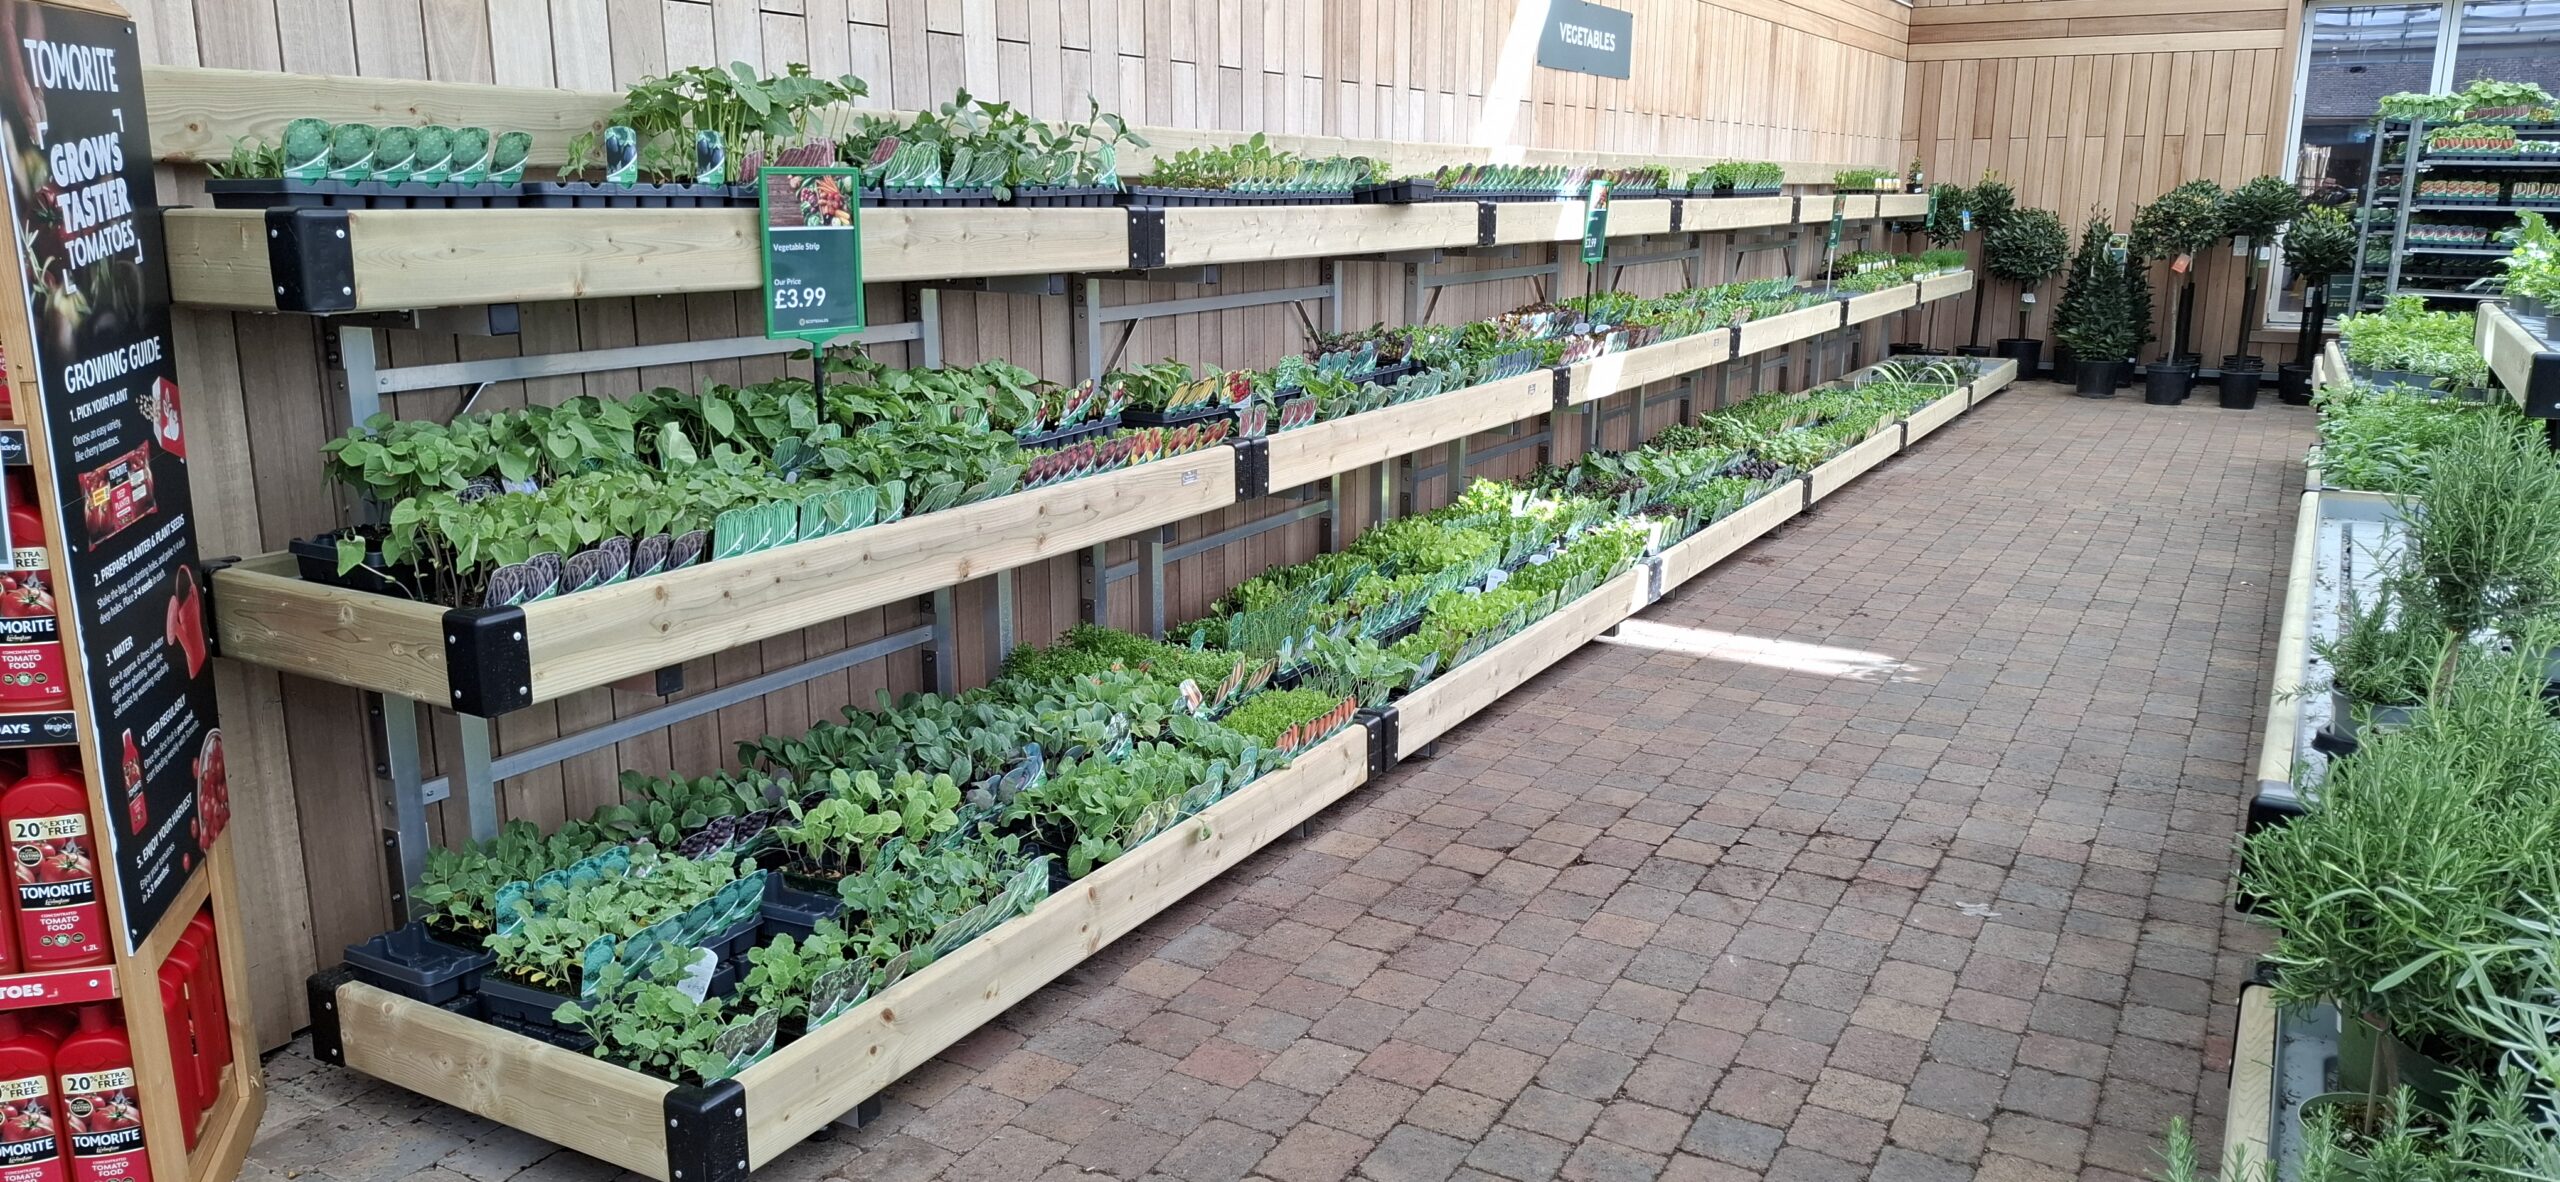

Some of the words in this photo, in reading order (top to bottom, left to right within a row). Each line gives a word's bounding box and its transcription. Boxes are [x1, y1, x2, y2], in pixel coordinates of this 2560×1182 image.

[1559, 21, 1616, 52] VEGETABLES
[23, 38, 119, 93] TOMORITE
[50, 132, 124, 187] GROWS
[56, 178, 132, 234] TASTIER
[65, 219, 135, 270] TOMATOES
[773, 242, 804, 252] Vegetable
[805, 241, 820, 252] Strip
[774, 278, 785, 286] Our
[786, 278, 801, 286] Price
[774, 287, 826, 309] £3.99
[64, 348, 128, 394] GROWING
[128, 336, 162, 370] GUIDE
[76, 402, 92, 420] PICK
[91, 396, 109, 413] YOUR
[108, 388, 128, 406] PLANT
[101, 554, 128, 582] PREPARE
[127, 538, 152, 564] PLANTER
[155, 523, 171, 545] PLANT
[170, 514, 185, 532] SEEDS
[112, 635, 134, 661] WATER
[2, 654, 42, 663] TOMATO
[9, 661, 36, 669] FOOD
[0, 724, 31, 735] AYS
[146, 721, 161, 743] FEED
[49, 818, 78, 827] EXTRA
[142, 833, 159, 862] ENJOY
[158, 817, 174, 842] YOUR
[172, 791, 193, 825] HARVEST
[19, 881, 92, 900] TOMORITE
[40, 916, 80, 925] TOMATO
[47, 923, 73, 931] FOOD
[11, 1080, 40, 1089] EXTRA
[99, 1071, 127, 1080] EXTRA
[0, 1138, 54, 1157] MORITE
[73, 1129, 140, 1148] TOMORITE
[92, 1161, 129, 1172] TOMATO
[98, 1169, 124, 1177] FOOD
